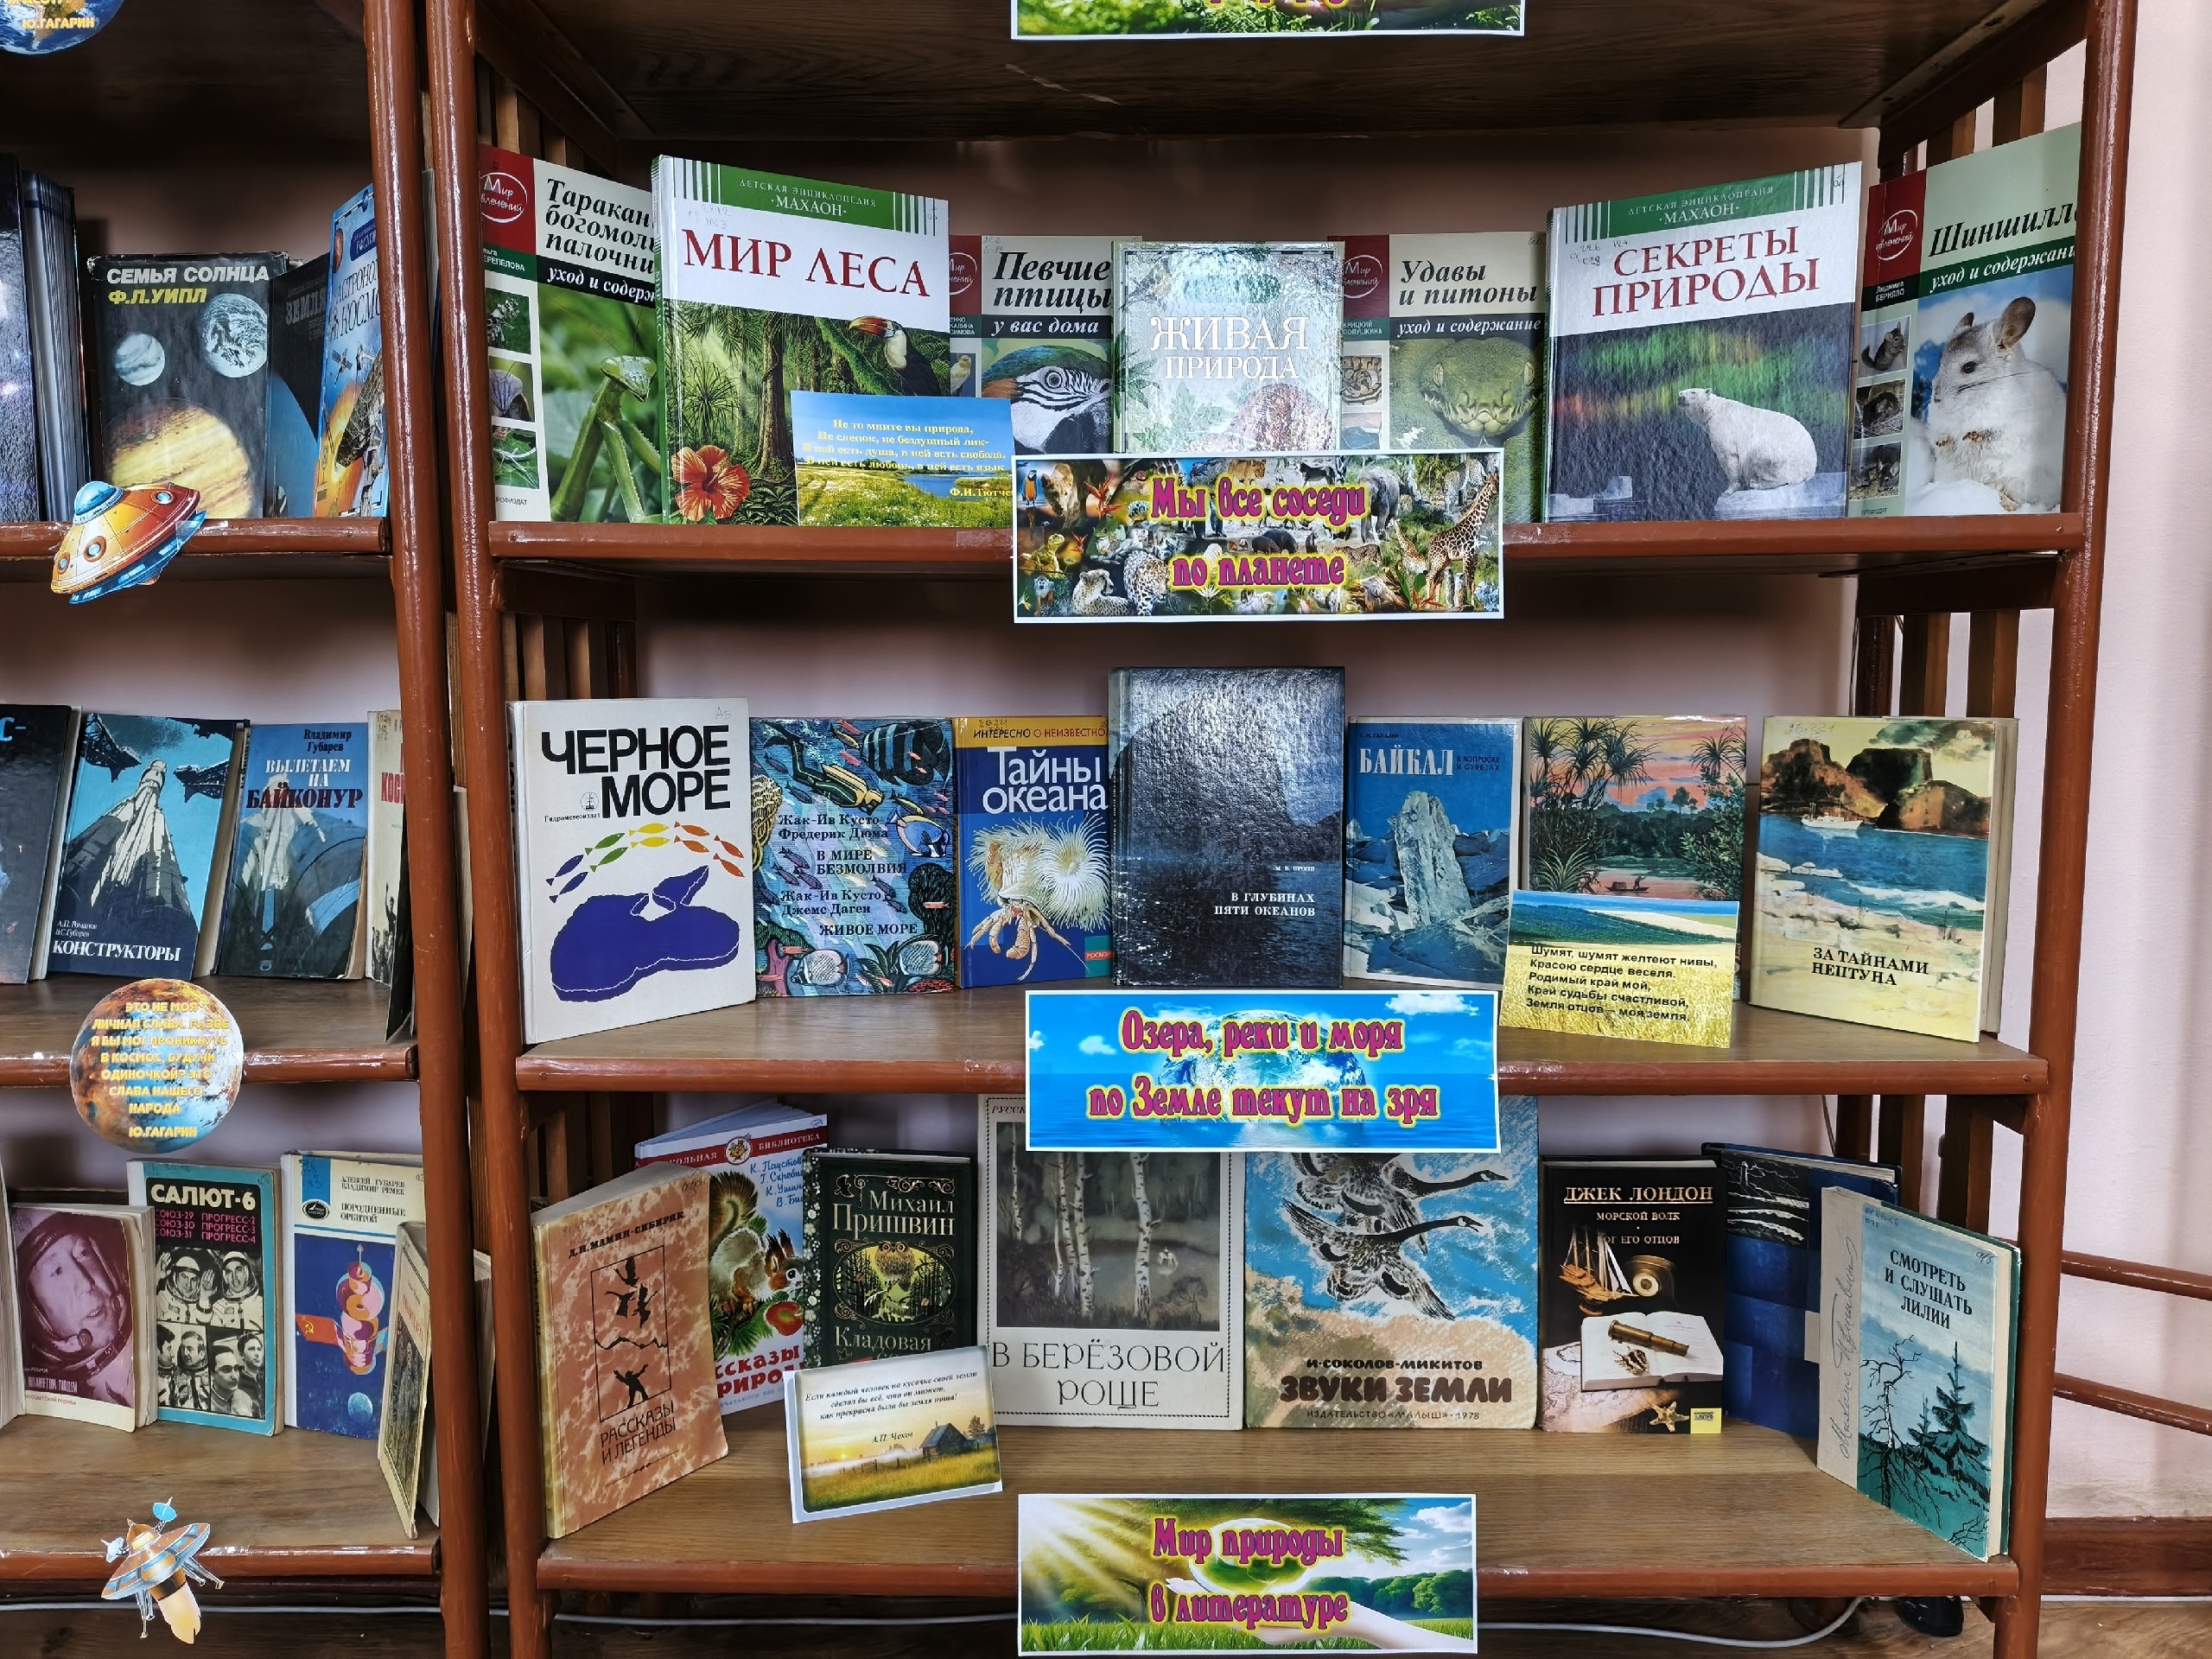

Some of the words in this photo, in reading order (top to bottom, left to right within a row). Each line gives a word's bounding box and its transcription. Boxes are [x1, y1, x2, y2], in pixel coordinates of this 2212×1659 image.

[484, 175, 513, 200] Мир
[739, 179, 788, 194] ДЕТСКАЯ
[791, 187, 878, 207] ЭНЦИКЛОПЕДИЯ
[1628, 200, 1677, 215] ДЕТСКАЯ
[1681, 186, 1773, 207] ЭНЦИКЛОПЕДИЯ
[1884, 219, 1907, 235] Мир
[1614, 226, 1798, 276] СЕКРЕТЫ
[682, 229, 792, 277] МИР
[805, 247, 931, 297] ЛЕСА
[992, 251, 1111, 281] Певчие
[1345, 262, 1370, 276] Мир
[1401, 260, 1486, 283] Удавы
[106, 267, 177, 284] СЕМЬЯ
[183, 265, 270, 283] СОЛНЦА
[547, 266, 584, 283] уход
[589, 276, 599, 289] и
[1929, 266, 1965, 294] уход
[1969, 266, 1979, 279] и
[108, 288, 207, 306] Ф.Л.УИПЛ
[1399, 289, 1414, 305] и
[1424, 285, 1537, 304] питоны
[1592, 258, 1820, 317] ПРИРОДЫ
[1876, 289, 1904, 302] БЕРИЛЛО
[994, 287, 1111, 314] птицы
[991, 321, 1004, 336] у
[1010, 321, 1041, 333] вас
[1049, 317, 1099, 334] дома
[1150, 316, 1309, 351] ЖИВАЯ
[1397, 319, 1429, 338] уход
[1436, 322, 1445, 333] и
[1450, 318, 1541, 334] содержание
[1165, 356, 1300, 384] ПРИРОДА
[925, 425, 974, 435] природа,
[898, 435, 960, 447] бездушный
[1152, 477, 1205, 518] Мы
[1218, 477, 1262, 517] все
[1273, 486, 1366, 526] соседи
[1173, 557, 1208, 587] по
[1219, 556, 1344, 586] планете
[303, 729, 353, 742] Владимир
[974, 728, 1031, 739] ИНТЕРЕСНО
[1033, 729, 1042, 738] О
[307, 741, 344, 754] Губарев
[542, 725, 730, 775] ЧЕРНОЕ
[265, 759, 351, 773] ВЫЛЕТАЕМ
[987, 746, 1101, 785] Тайны
[1359, 745, 1454, 776] БАЙКАЛ
[308, 773, 329, 787] НА
[245, 781, 364, 809] БАЙКОНУР
[601, 768, 731, 818] МОРЕ
[982, 784, 1109, 814] океана
[779, 815, 836, 826] Жак-Ив
[839, 815, 880, 827] Кусто
[779, 828, 845, 842] Фредерик
[849, 829, 888, 840] Дюма
[817, 850, 826, 861] В
[831, 849, 873, 861] МИРЕ
[817, 863, 907, 875] БЕЗМОЛВИЯ
[780, 890, 838, 901] Жак-Ив
[1231, 893, 1239, 902] В
[1243, 893, 1315, 903] ГЛУБИНАХ
[782, 904, 827, 917] Джемс
[830, 904, 871, 915] Даген
[1214, 906, 1249, 915] ПЯТИ
[1255, 906, 1315, 917] ОКЕАНОВ
[819, 925, 873, 936] ЖИВОЕ
[877, 924, 918, 935] МОРЕ
[52, 940, 181, 962] КОНСТРУКТОРЫ
[1531, 945, 1574, 958] Шумят,
[1579, 952, 1618, 963] шумят
[1622, 954, 1677, 965] желтеют
[1680, 958, 1718, 969] нивы,
[1814, 947, 1835, 962] ЗА
[1838, 949, 1929, 975] ТАЙНАМИ
[1530, 959, 1577, 972] Красою
[1580, 963, 1624, 976] сердце
[1628, 969, 1676, 979] веселя.
[1812, 962, 1897, 986] НЕПТУНА
[1529, 972, 1586, 986] Родимый
[1590, 977, 1619, 990] край
[1623, 981, 1651, 992] мой,
[1528, 985, 1556, 997] Край
[1560, 989, 1607, 1001] судьбы
[1611, 994, 1689, 1008] счастливой,
[125, 1002, 150, 1013] ЭТО
[152, 1002, 168, 1012] НЕ
[170, 1002, 198, 1012] МОЯ
[1527, 998, 1565, 1010] Земля
[1567, 1002, 1604, 1014] отцов
[1618, 1008, 1644, 1018] моя
[1647, 1011, 1690, 1022] земля.
[92, 1020, 140, 1030] ЛИЧНАЯ
[189, 1020, 229, 1030] РАЗВЕ
[1122, 1009, 1213, 1058] Озера,
[1224, 1021, 1289, 1057] реки
[1302, 1021, 1320, 1050] и
[1329, 1020, 1404, 1058] моря
[149, 1037, 228, 1046] ПРОНИКНУТЬ
[100, 1053, 109, 1063] В
[168, 1053, 215, 1064] БУДУЧИ
[189, 1070, 213, 1080] ЭТО
[109, 1086, 149, 1096] СЛАВА
[152, 1086, 203, 1096] НАШЕГО
[1089, 1090, 1122, 1116] по
[1133, 1075, 1222, 1117] Земле
[1232, 1087, 1332, 1123] текут
[1342, 1088, 1376, 1116] на
[1387, 1086, 1439, 1125] зря
[129, 1103, 181, 1115] НАРОДА
[128, 1127, 198, 1138] Ю.ГАГАРИН
[759, 1133, 820, 1150] БИБЛИОТЕКА
[376, 1179, 404, 1188] ГУБАРЕВ
[151, 1184, 256, 1210] САЛЮТ-6
[869, 1191, 954, 1213] Михаил
[1563, 1186, 1622, 1203] ДЖЕК
[1629, 1186, 1713, 1202] ЛОНДОН
[201, 1213, 256, 1224] ПРОГРЕСС-2
[340, 1212, 378, 1223] ОРБИТОЙ
[832, 1203, 955, 1241] Пришвин
[1597, 1211, 1648, 1220] МОРСКОЙ
[201, 1222, 256, 1234] ПРОГРЕСС-3
[201, 1232, 256, 1243] ПРОГРЕСС-4
[1643, 1236, 1680, 1244] ОТЦОВ
[1890, 1249, 1966, 1292] СМОТРЕТЬ
[1885, 1268, 1894, 1284] И
[1901, 1275, 1972, 1315] СЛУШАТЬ
[1901, 1296, 1950, 1329] ЛИЛИИ
[835, 1326, 931, 1352] Кладовая
[993, 1343, 1010, 1367] В
[1023, 1339, 1224, 1372] БЕРЁЗОВОЙ
[1058, 1380, 1160, 1410] РОЩЕ
[1280, 1375, 1388, 1402] ЗВУКИ
[1395, 1376, 1512, 1403] ЗЕМЛИ
[601, 1399, 675, 1447] РАССКАЗЫ
[1306, 1410, 1387, 1419] ИЗДАТЕЛЬСТВО
[1454, 1412, 1480, 1421] 1978
[602, 1445, 612, 1464] И
[614, 1422, 676, 1460] ЛЕГЕНДЫ
[1154, 1518, 1211, 1563] Мир
[1222, 1529, 1343, 1566] природы
[1152, 1582, 1165, 1622] в
[1176, 1592, 1347, 1629] литературе
